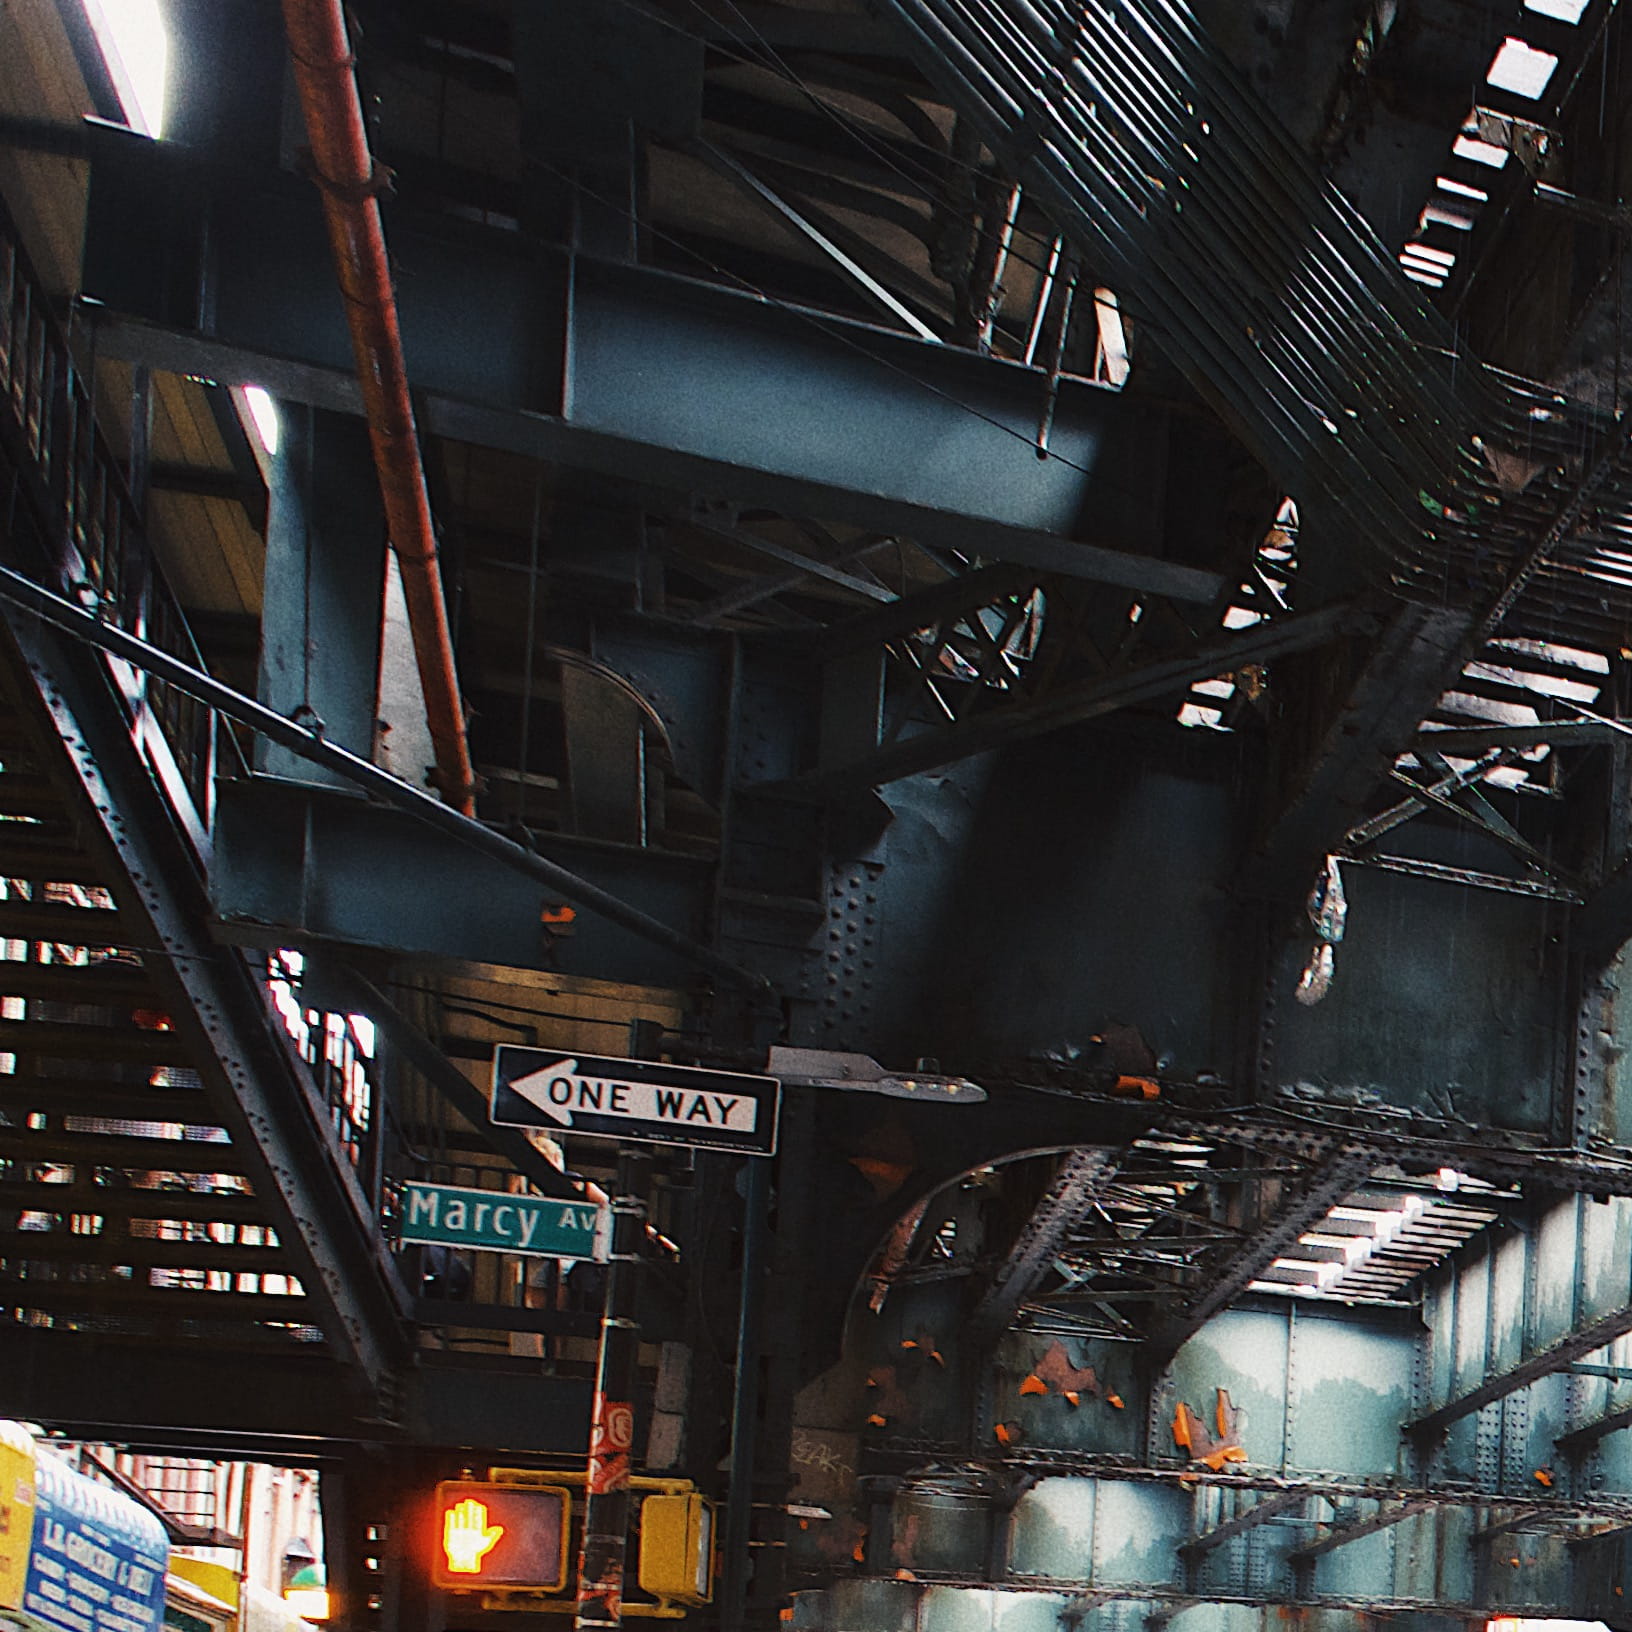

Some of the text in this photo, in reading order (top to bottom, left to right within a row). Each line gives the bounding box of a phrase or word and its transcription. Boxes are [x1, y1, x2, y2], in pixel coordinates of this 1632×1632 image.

[549, 1076, 739, 1125] ONE WAY
[408, 1188, 597, 1248] Marcy Av
